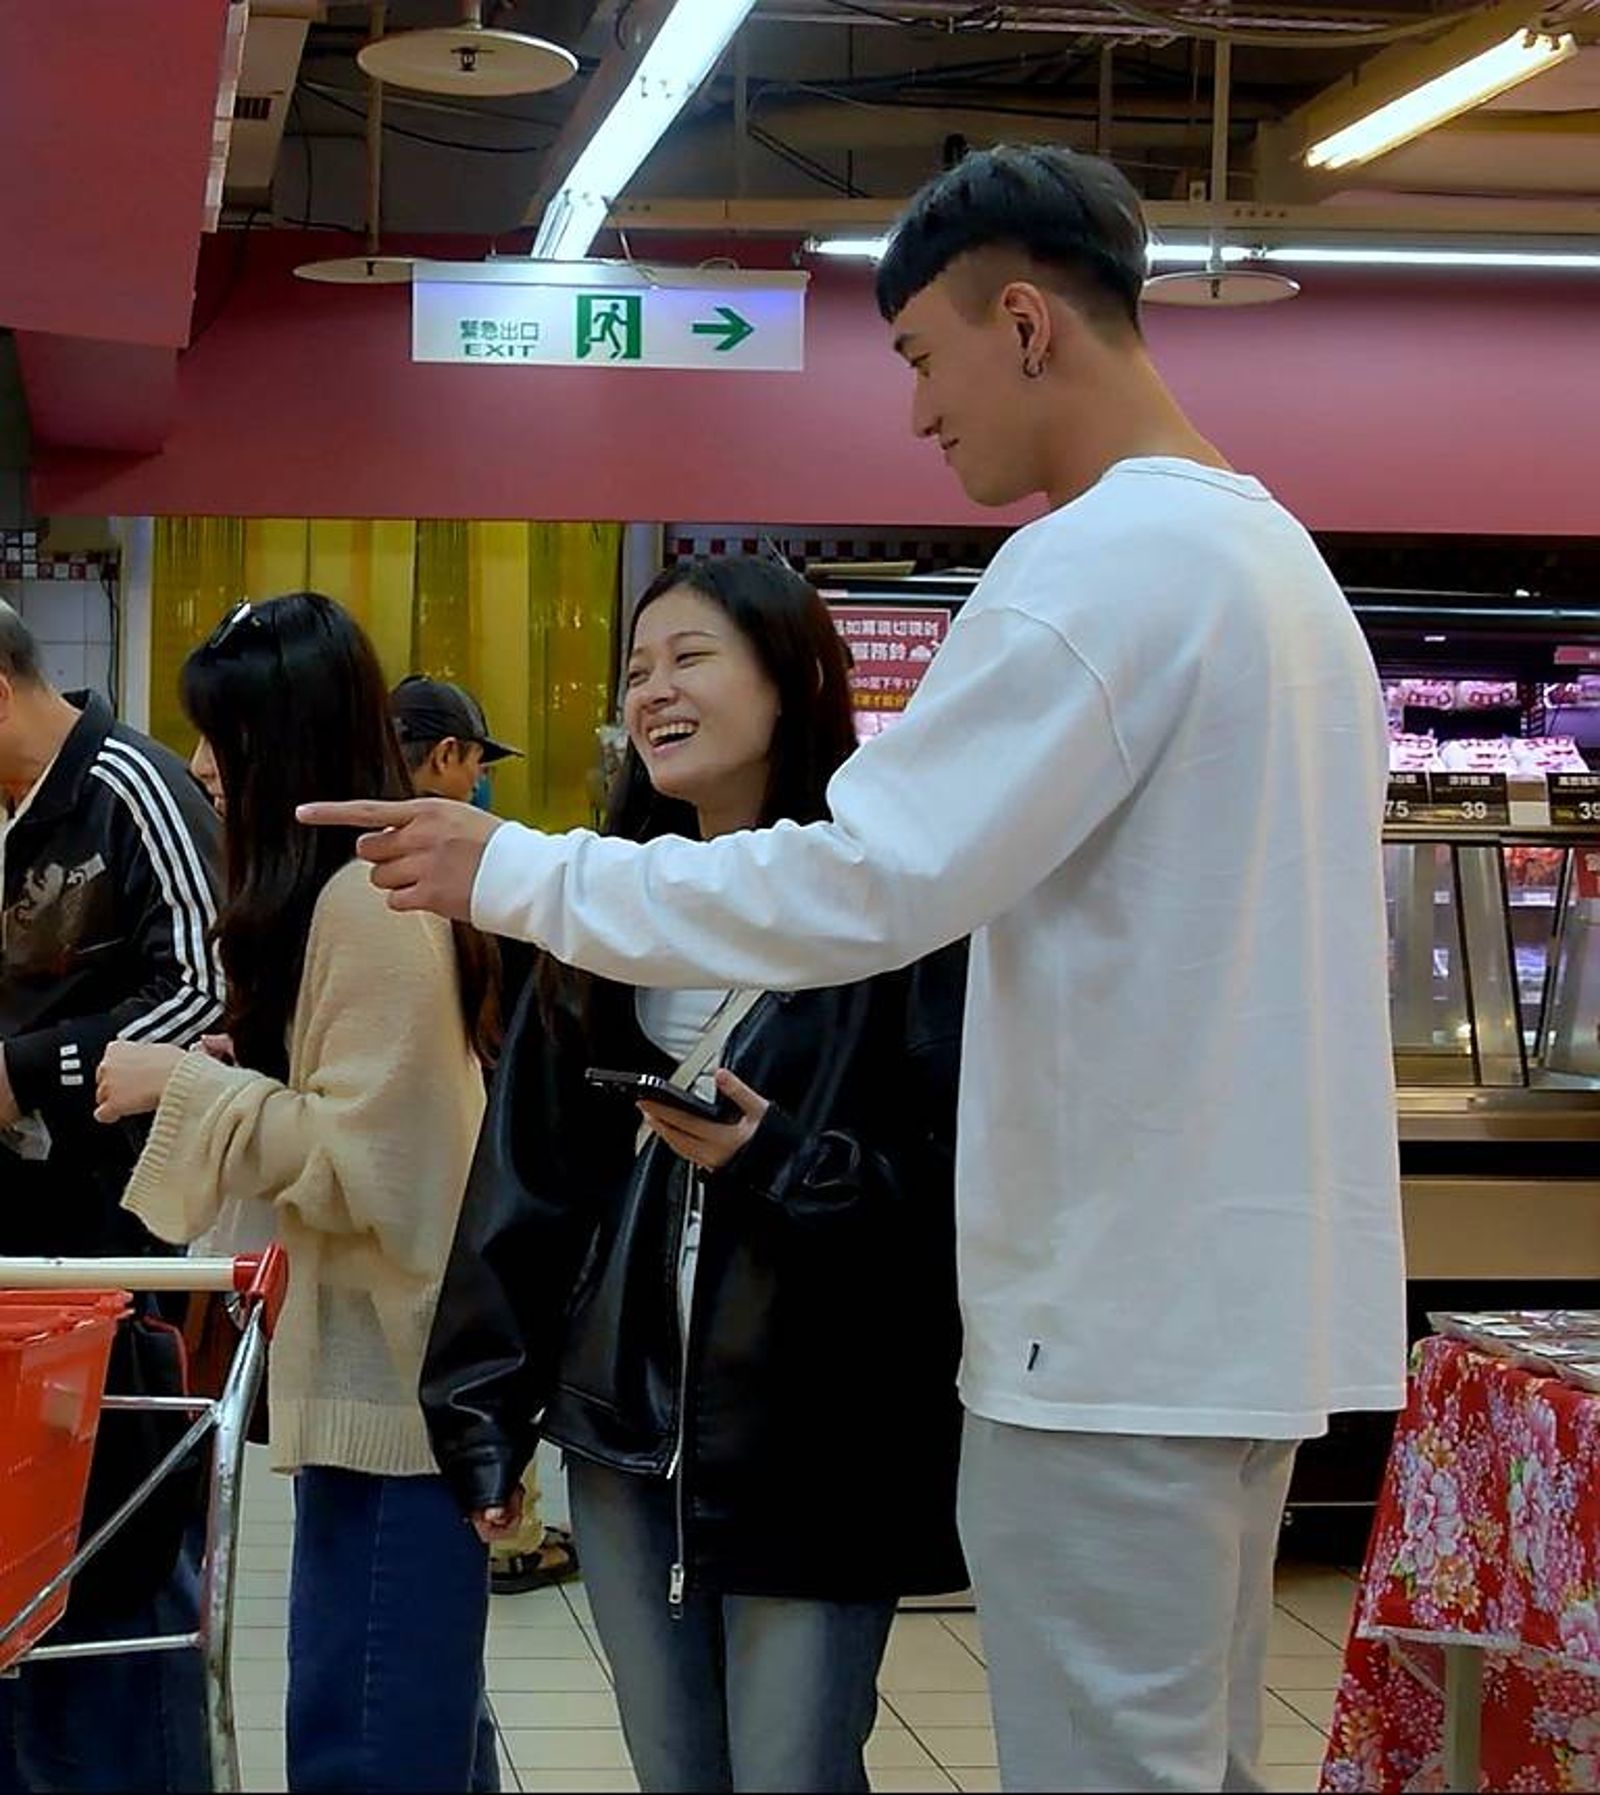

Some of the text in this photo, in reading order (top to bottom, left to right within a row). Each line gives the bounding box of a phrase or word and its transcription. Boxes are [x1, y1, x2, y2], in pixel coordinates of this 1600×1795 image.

[460, 320, 539, 341] 緊急出口
[465, 343, 535, 357] EXIT
[1461, 801, 1487, 819] 39
